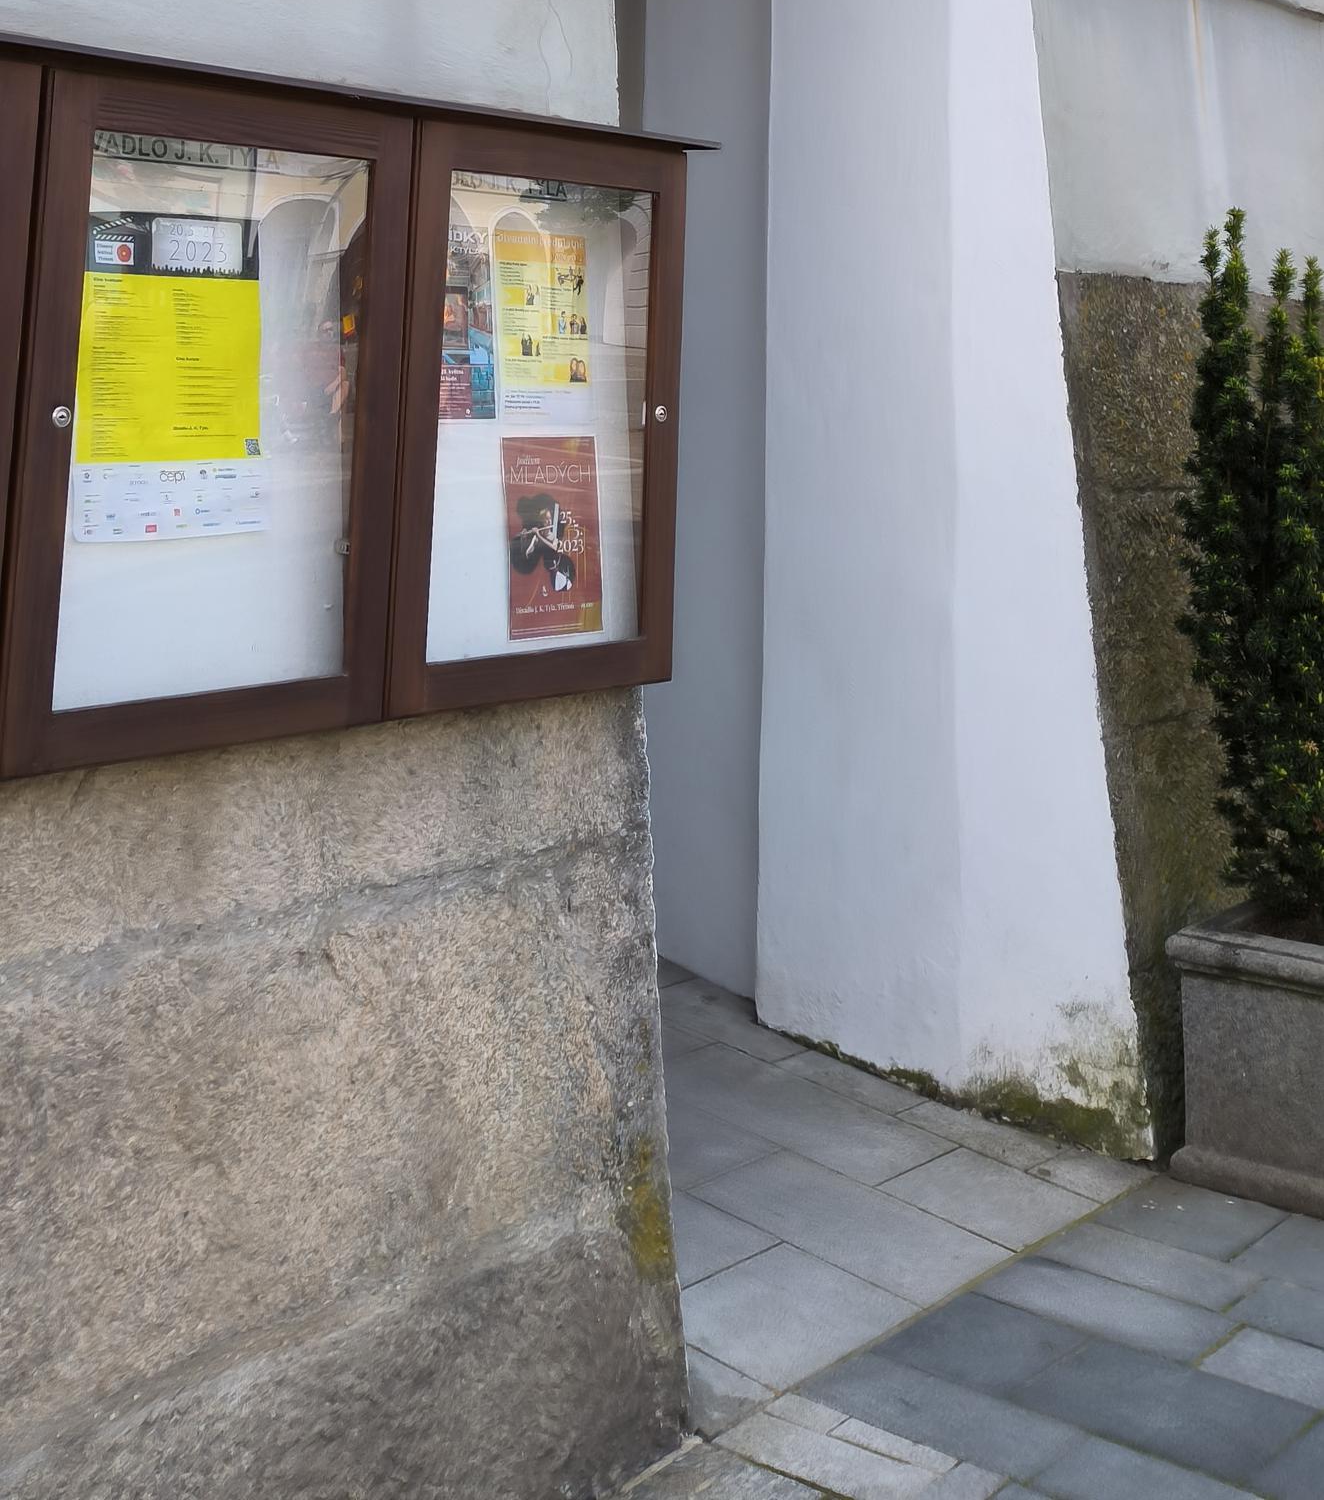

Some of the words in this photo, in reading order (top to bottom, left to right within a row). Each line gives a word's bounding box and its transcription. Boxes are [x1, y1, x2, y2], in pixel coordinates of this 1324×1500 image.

[174, 141, 192, 161] J.
[169, 239, 227, 263] 2023
[510, 461, 591, 485] MLADÝCH
[557, 538, 584, 554] 2023
